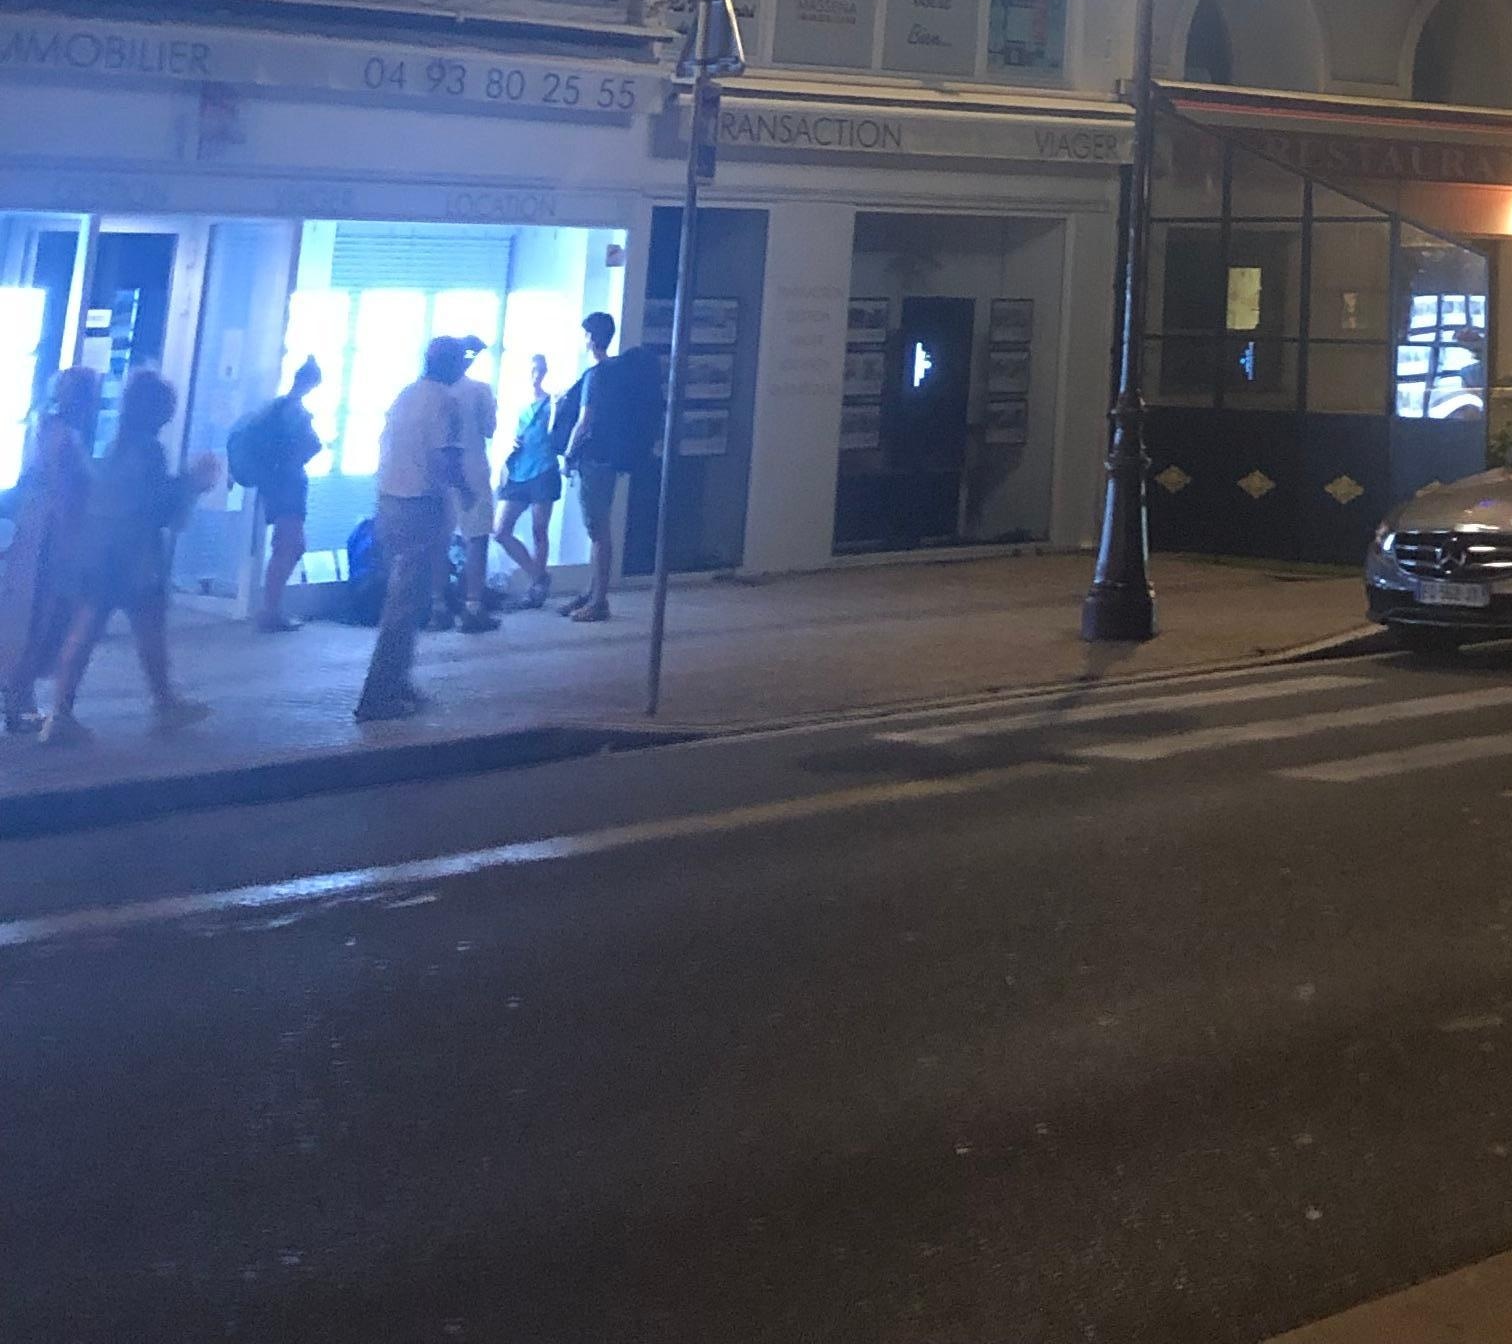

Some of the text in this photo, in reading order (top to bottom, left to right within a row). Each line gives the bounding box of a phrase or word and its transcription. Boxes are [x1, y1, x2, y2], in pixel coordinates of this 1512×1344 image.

[363, 57, 636, 110] 04 93 80 25 55
[1033, 126, 1120, 161] VIAGER
